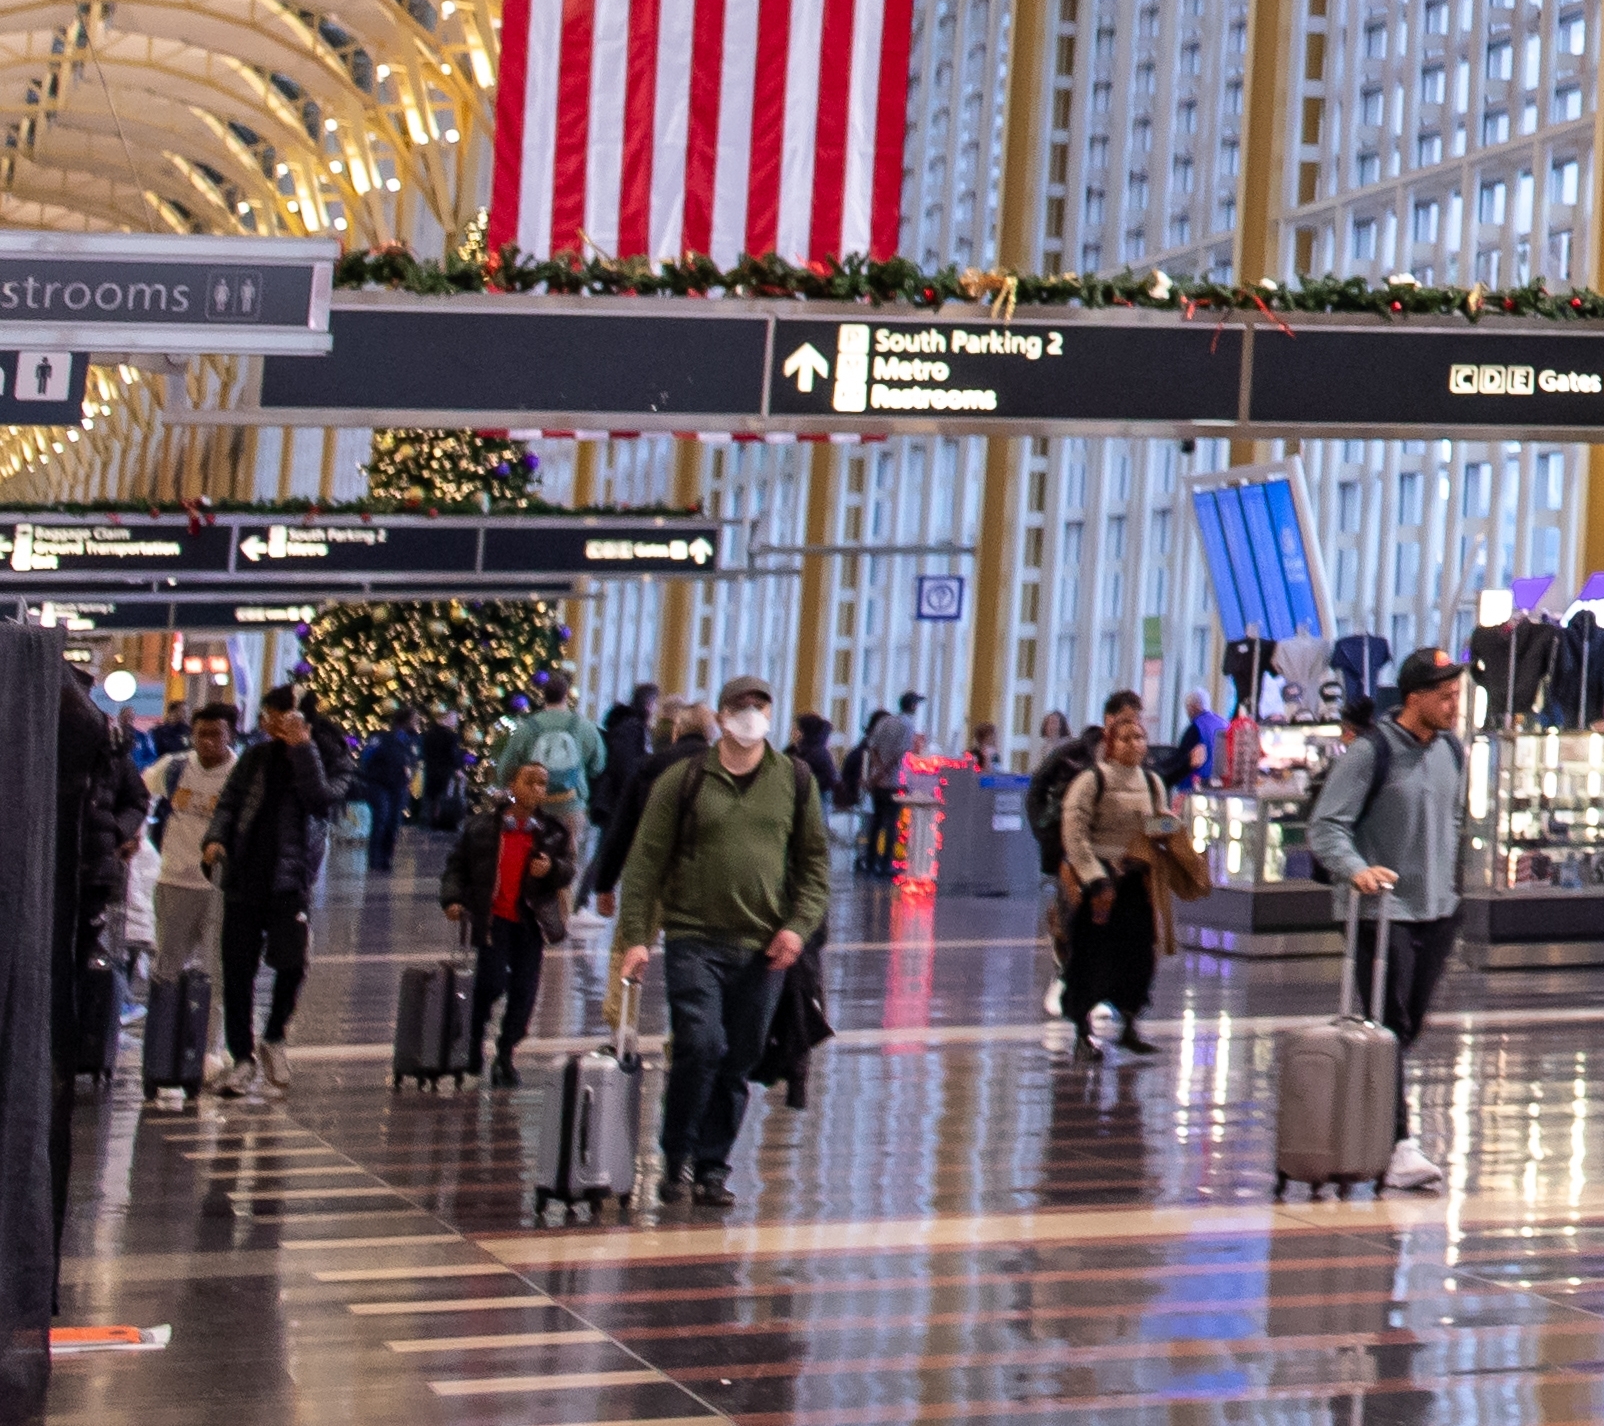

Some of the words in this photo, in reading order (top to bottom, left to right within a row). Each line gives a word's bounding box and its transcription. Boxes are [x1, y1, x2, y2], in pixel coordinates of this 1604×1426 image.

[875, 328, 947, 354] South
[951, 329, 1043, 360] Parking
[1046, 331, 1064, 356] 2
[872, 355, 950, 382] Metro
[1538, 369, 1602, 394] Gates
[870, 383, 997, 411] Restrooms
